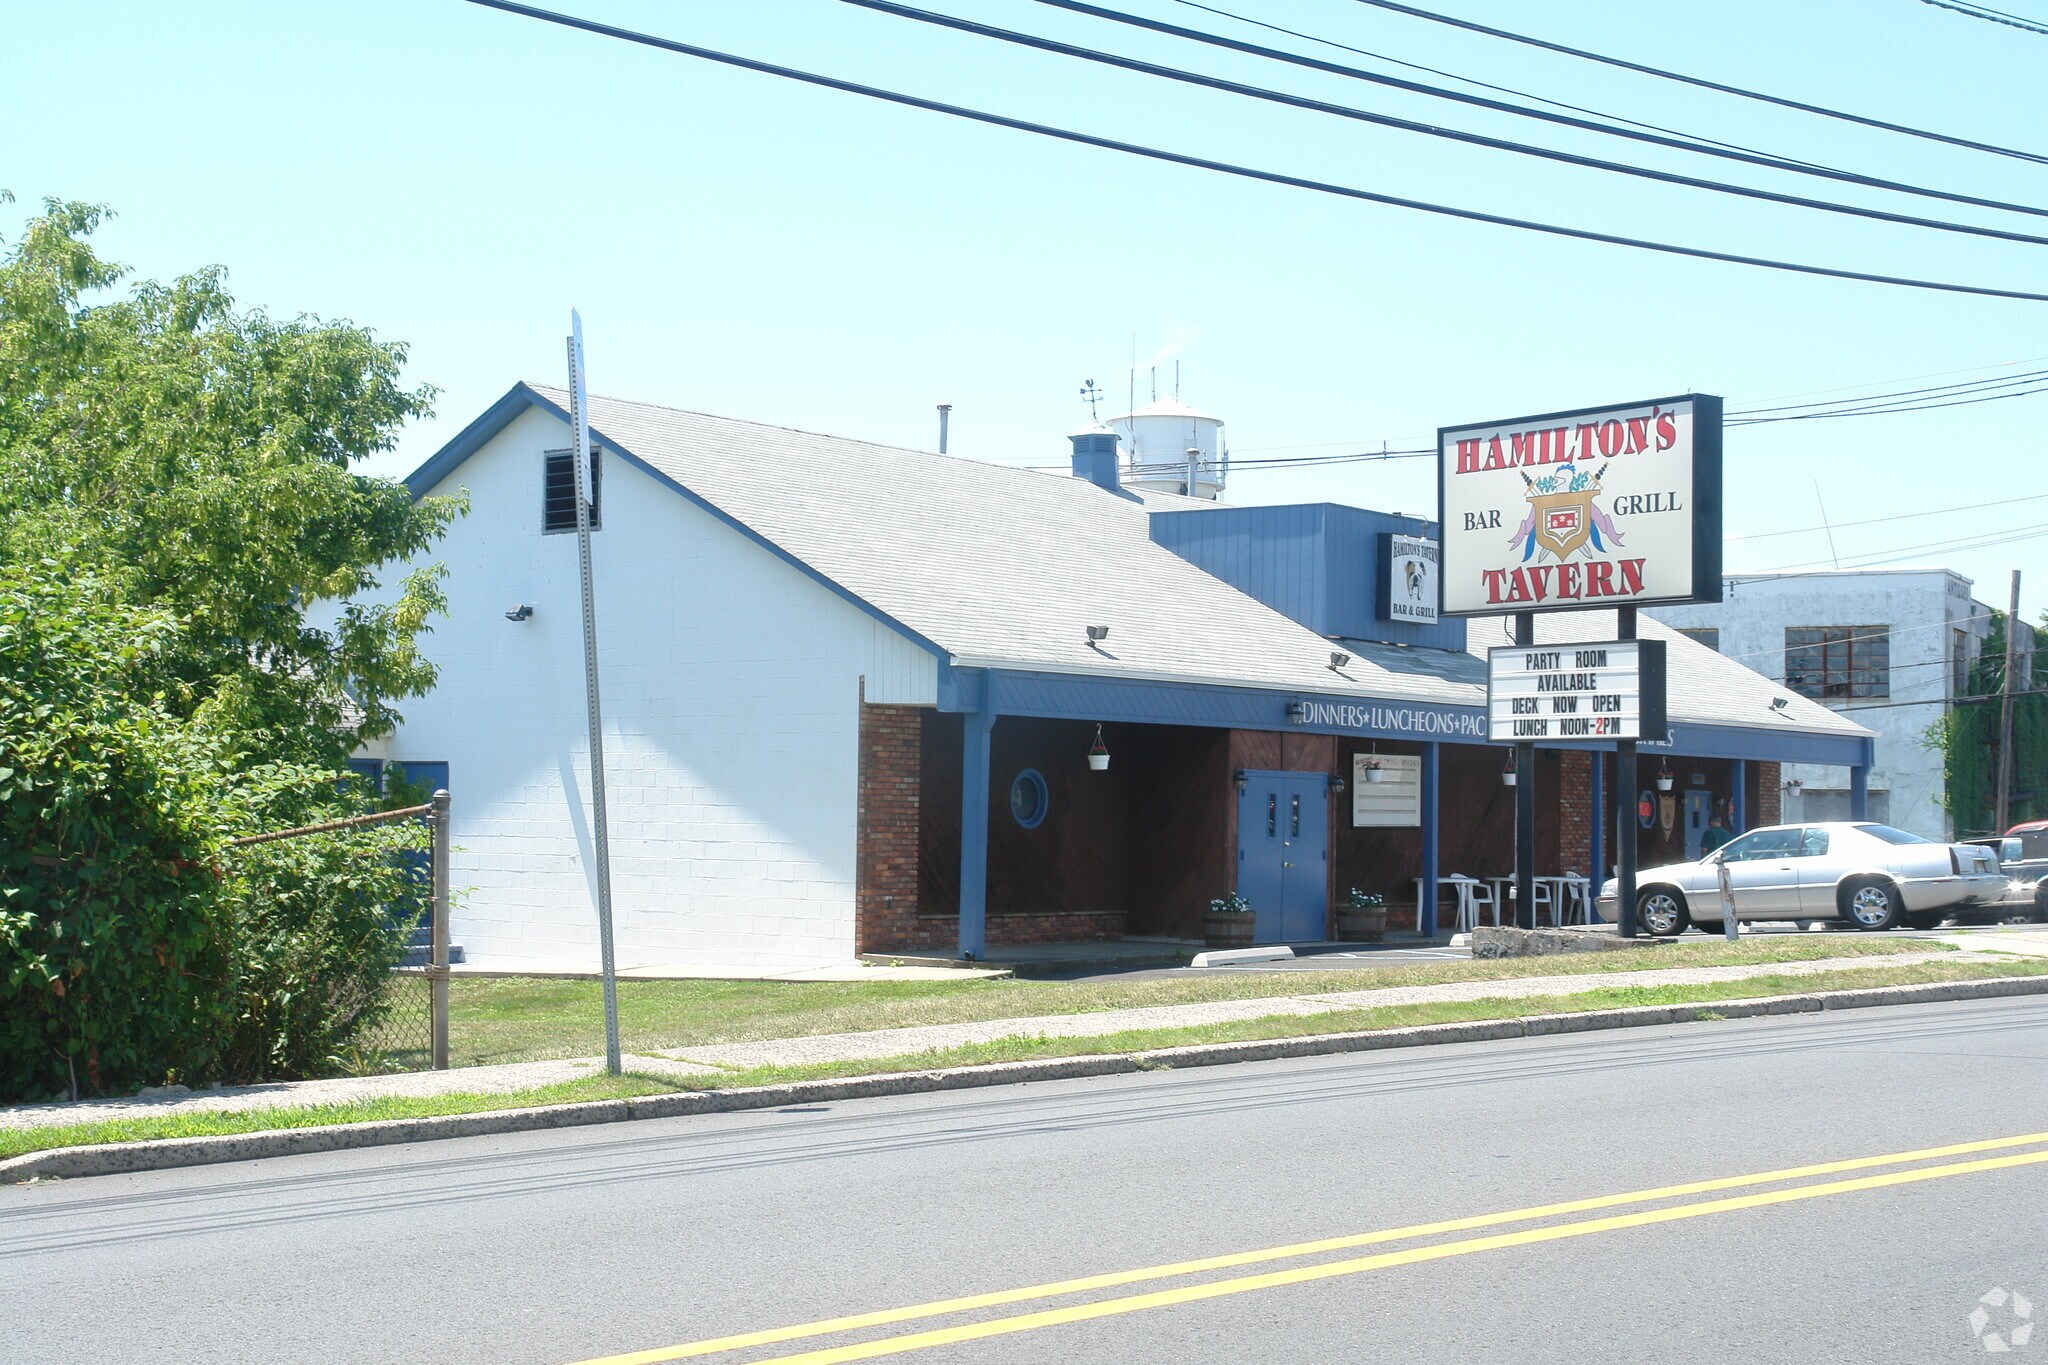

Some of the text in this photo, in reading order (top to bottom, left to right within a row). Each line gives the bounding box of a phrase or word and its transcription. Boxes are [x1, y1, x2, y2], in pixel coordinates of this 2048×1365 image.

[1455, 405, 1677, 475] HAMILTON'S
[1463, 491, 1683, 531] BAR GRILL
[1393, 541, 1439, 564] HAMILTON'S TAVERN
[1482, 558, 1647, 605] TAVERN
[1393, 603, 1436, 618] BAR & GRILL
[1526, 650, 1607, 670] PARTY ROOM
[1537, 673, 1597, 692] AVAILABLE
[1512, 694, 1621, 714] DECK NOW OPEN
[1302, 702, 1487, 736] DINNERS LUNCHEONS PAC
[1513, 717, 1621, 737] LUNCH NOON-2PM
